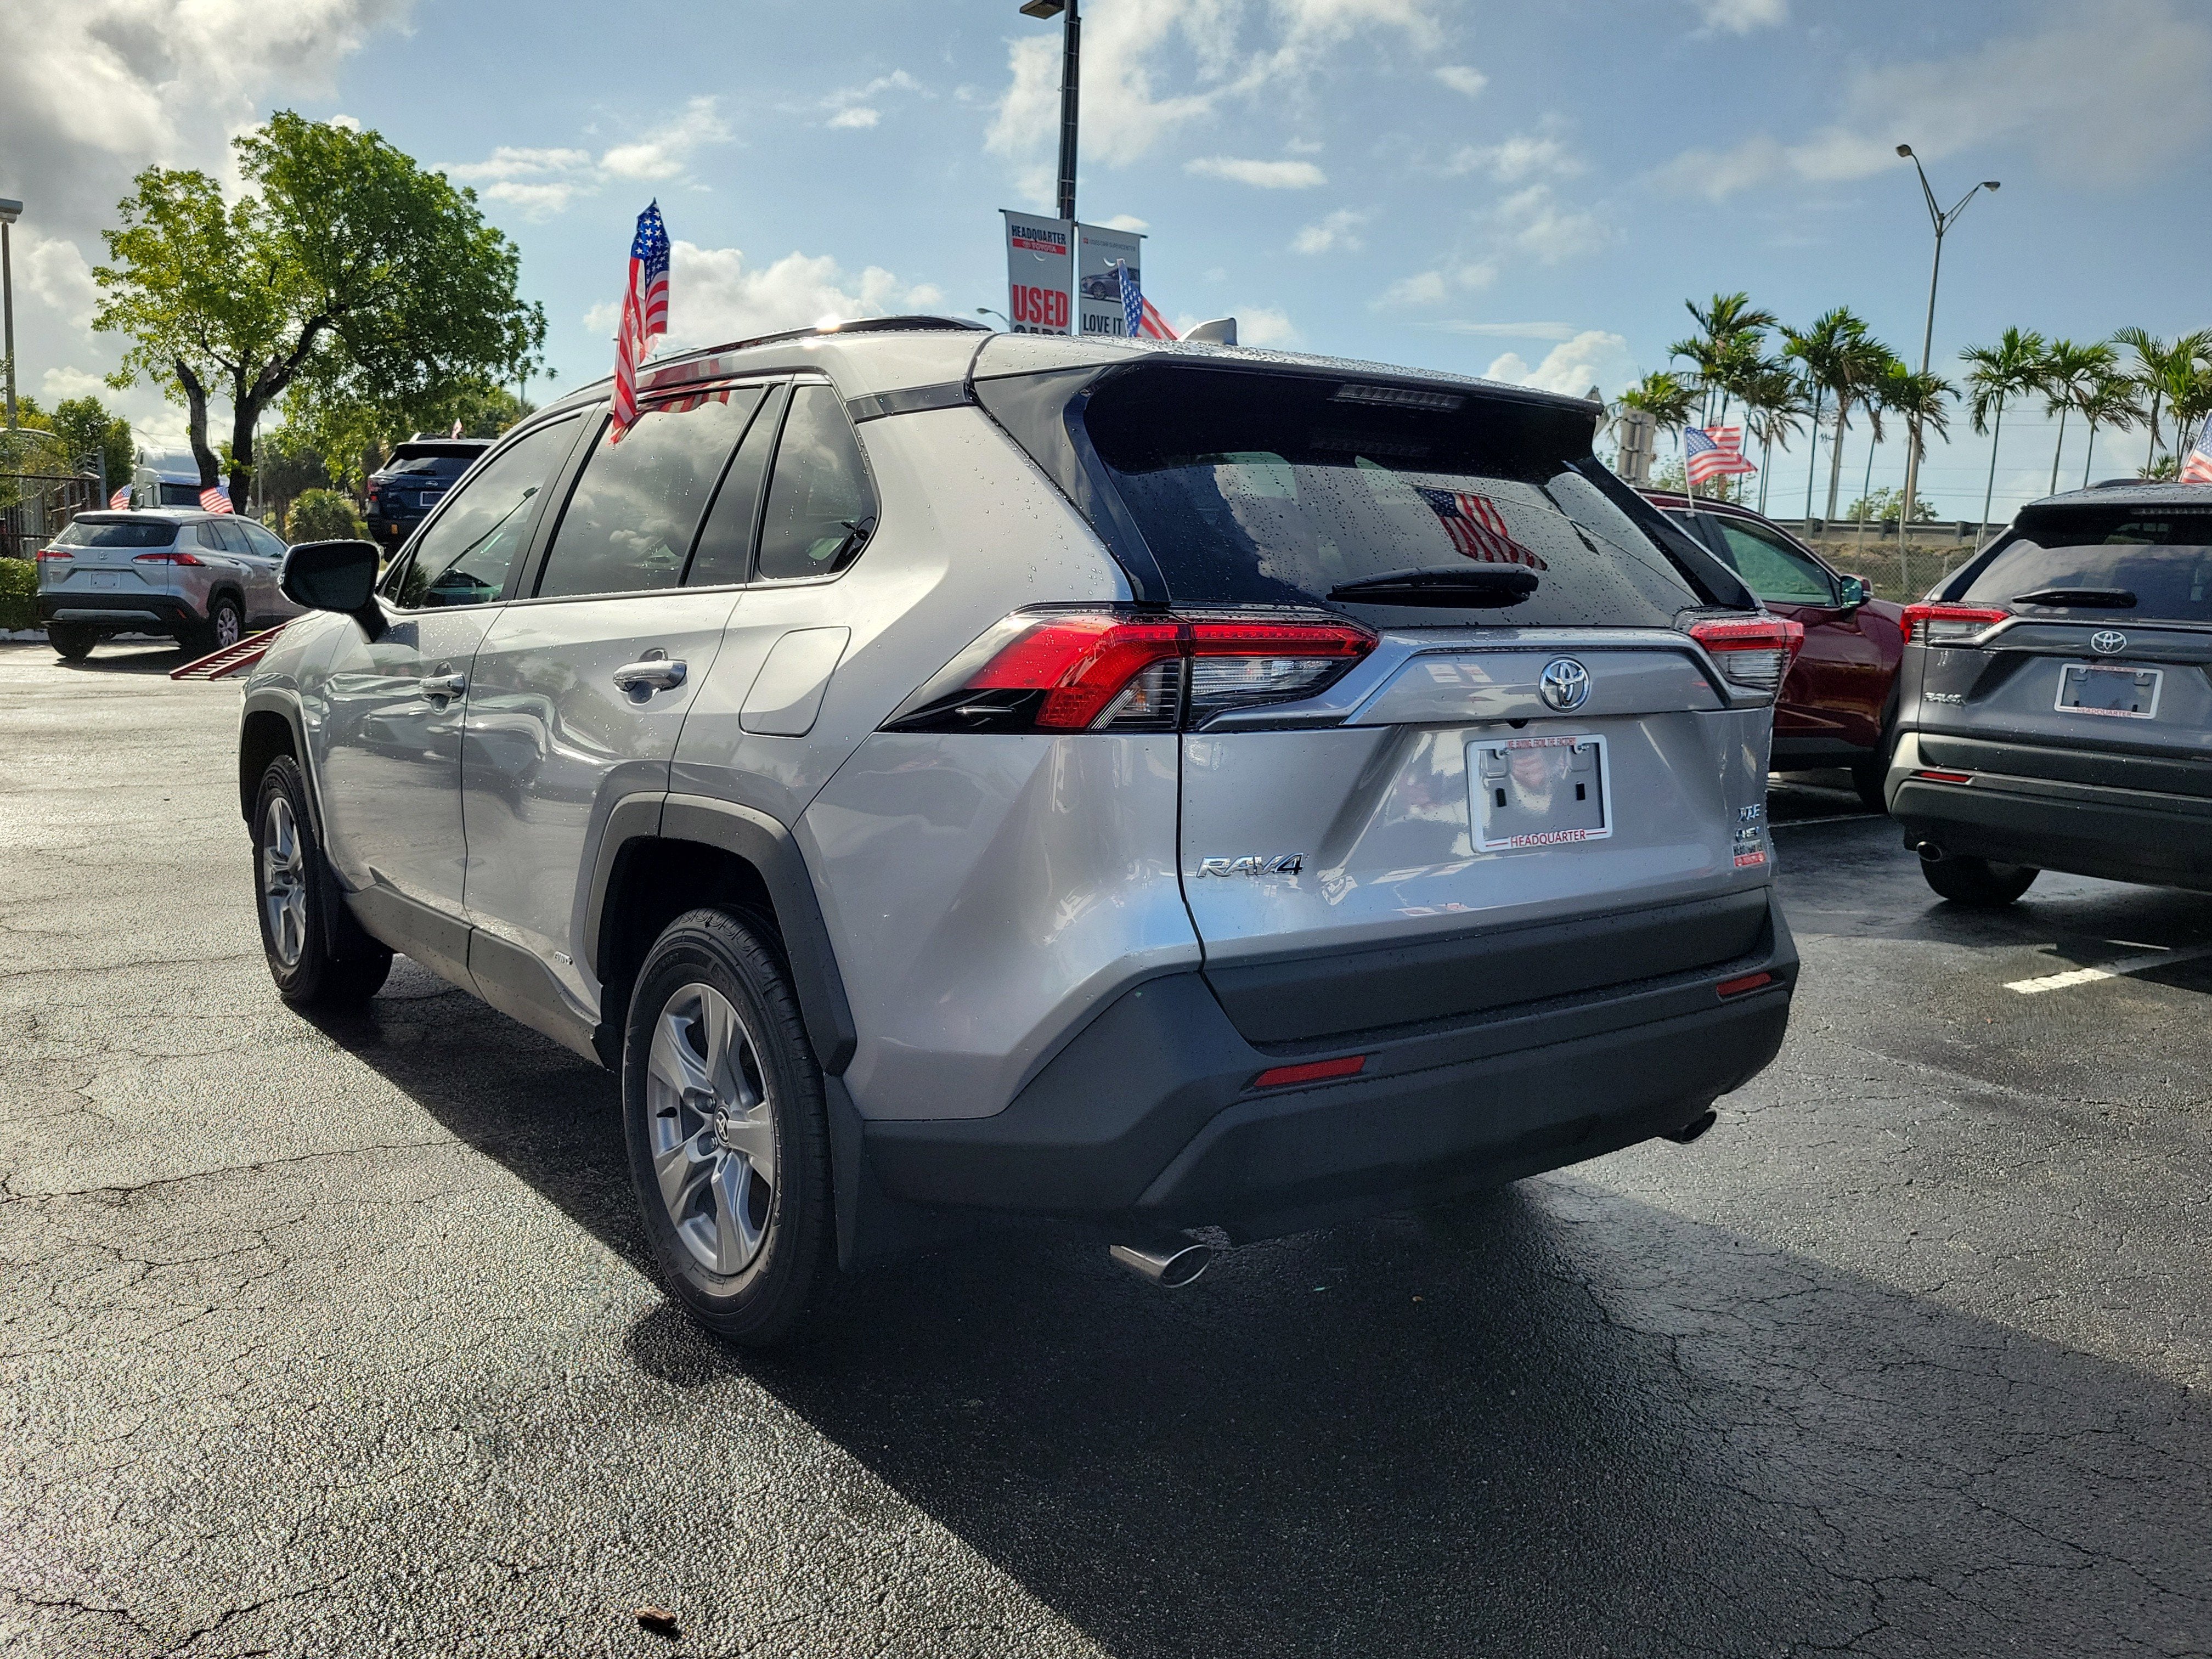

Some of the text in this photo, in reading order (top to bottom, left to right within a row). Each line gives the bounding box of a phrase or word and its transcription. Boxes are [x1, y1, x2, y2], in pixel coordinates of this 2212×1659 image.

[1012, 225, 1066, 245] HEADQUARTER
[1012, 284, 1068, 327] USED
[1083, 313, 1109, 332] LOVE
[1111, 318, 1123, 335] IT
[1533, 739, 1546, 747] FROM
[1510, 830, 1586, 847] HEADQUARTER
[1196, 853, 1305, 879] RAV4
